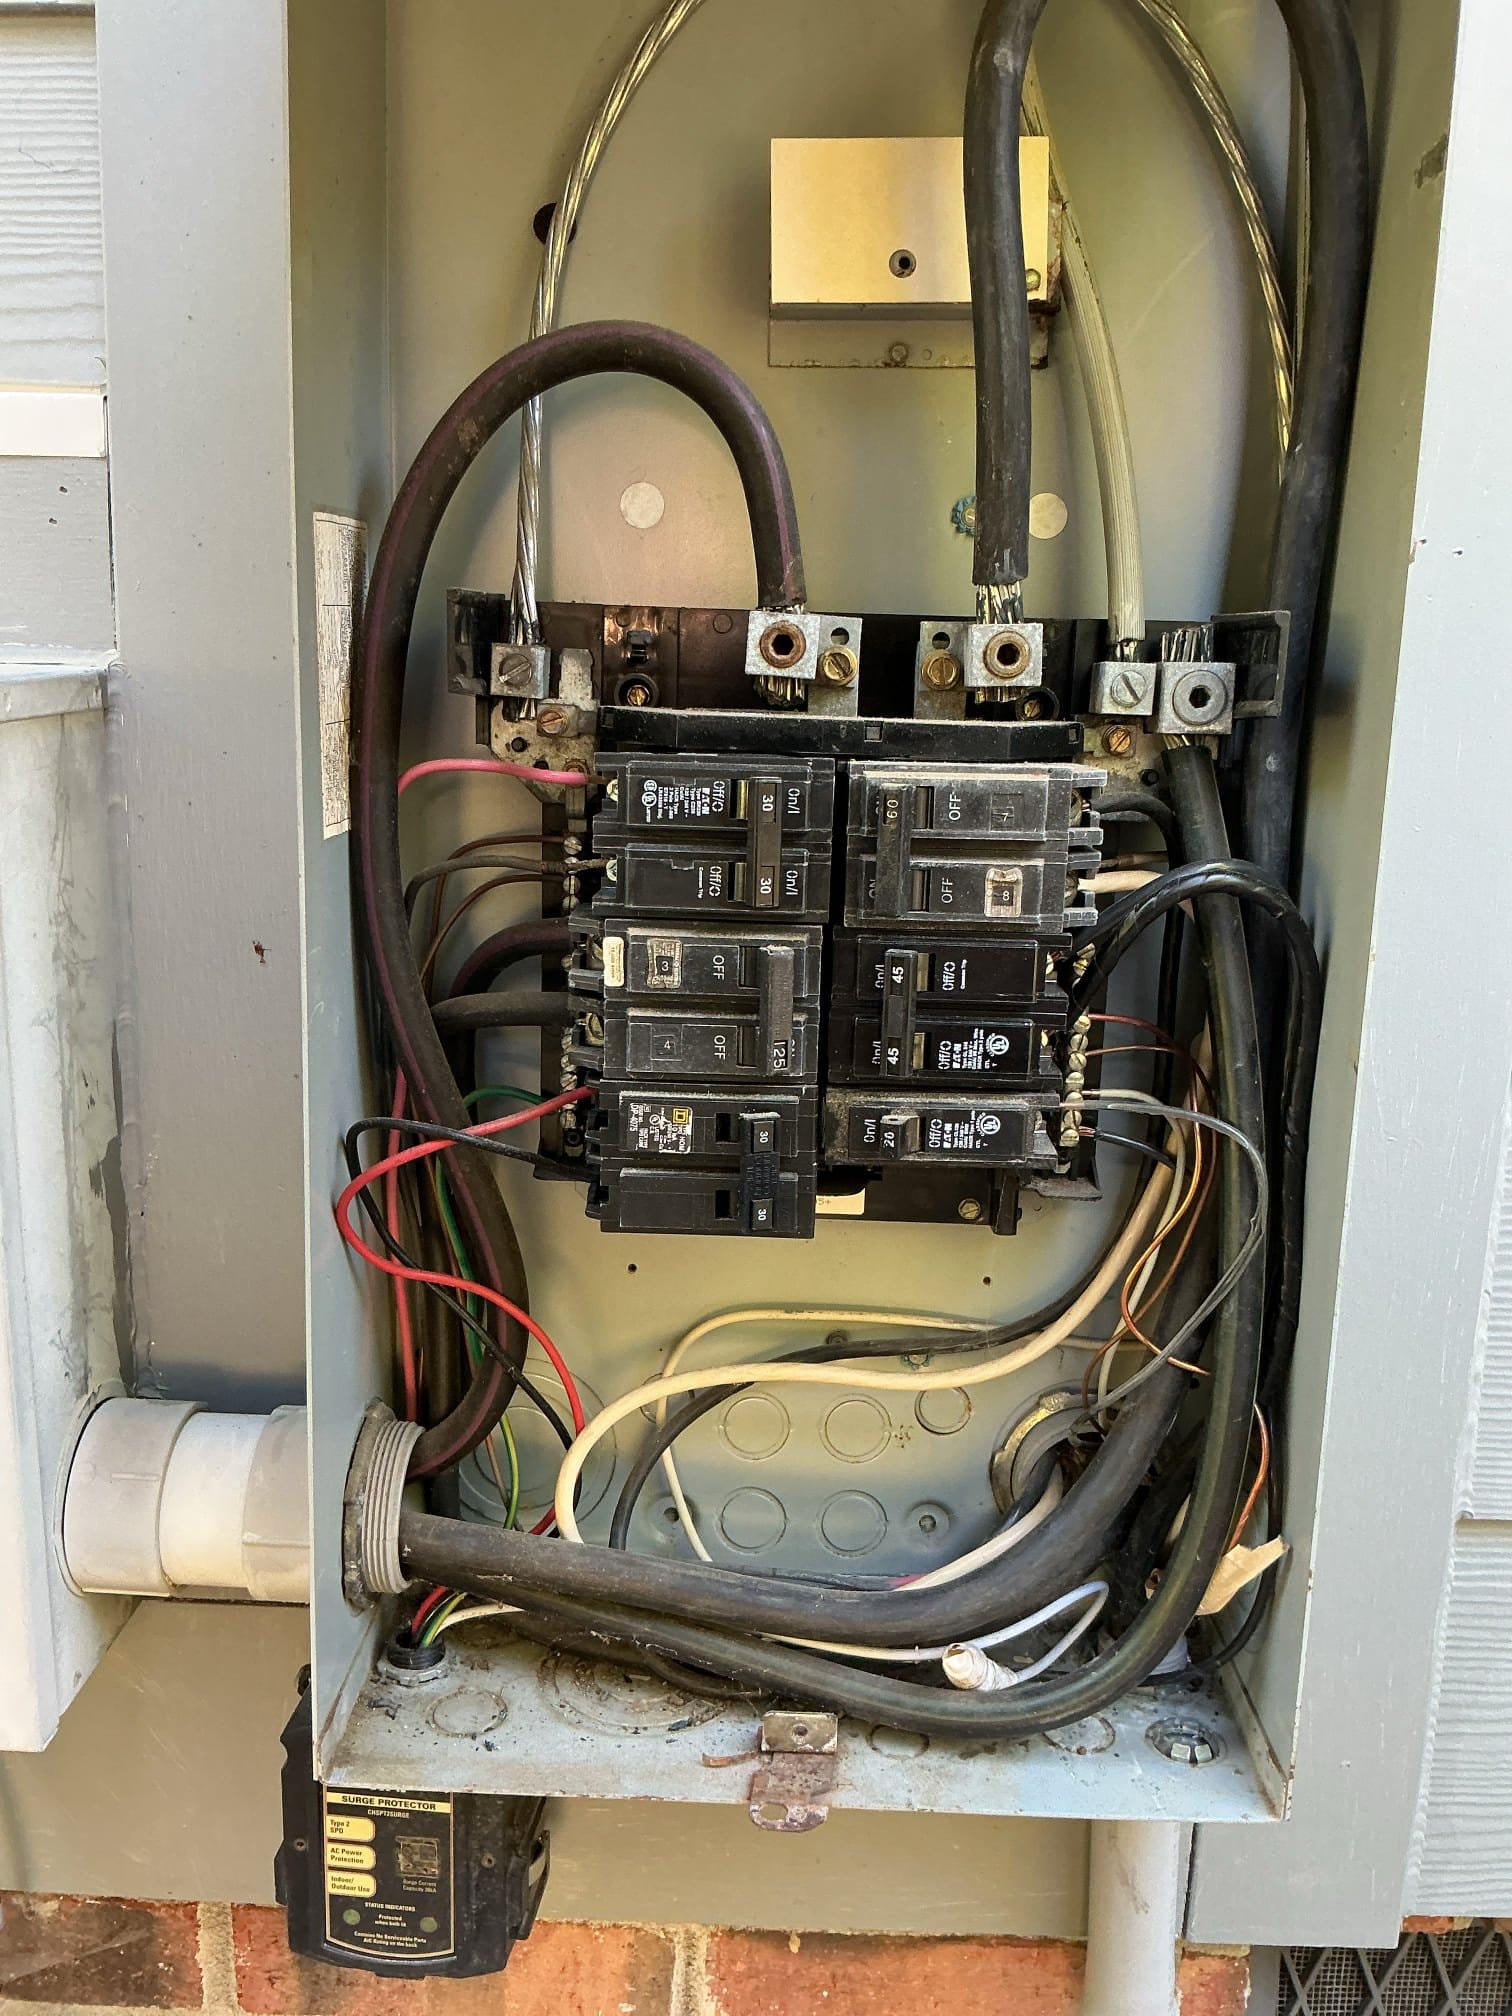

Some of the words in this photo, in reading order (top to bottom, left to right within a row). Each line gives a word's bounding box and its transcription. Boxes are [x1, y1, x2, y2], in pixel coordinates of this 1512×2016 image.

[762, 794, 774, 812] 30
[886, 799, 898, 819] 60
[949, 792, 961, 820] OFF
[1002, 812, 1009, 822] 7
[760, 878, 772, 894] 30
[941, 878, 953, 904] OFF
[1002, 890, 1010, 901] 8
[661, 961, 669, 971] 3
[712, 954, 724, 980] OFF
[892, 966, 904, 984] 45
[664, 1040, 671, 1050] 4
[714, 1034, 726, 1060] OFF
[774, 1040, 786, 1069] 125
[887, 1047, 898, 1064] 45
[630, 1104, 639, 1132] DP-4075
[760, 1130, 769, 1143] 30
[884, 1131, 894, 1148] 20
[758, 1208, 767, 1221] 30
[342, 1795, 376, 1806] SURGE
[378, 1799, 436, 1810] PROTECTOR
[330, 1819, 346, 1828] Type
[342, 1848, 362, 1856] Power
[330, 1856, 364, 1864] Protection
[331, 1876, 354, 1884] Indoor/
[331, 1884, 356, 1892] Outdoor
